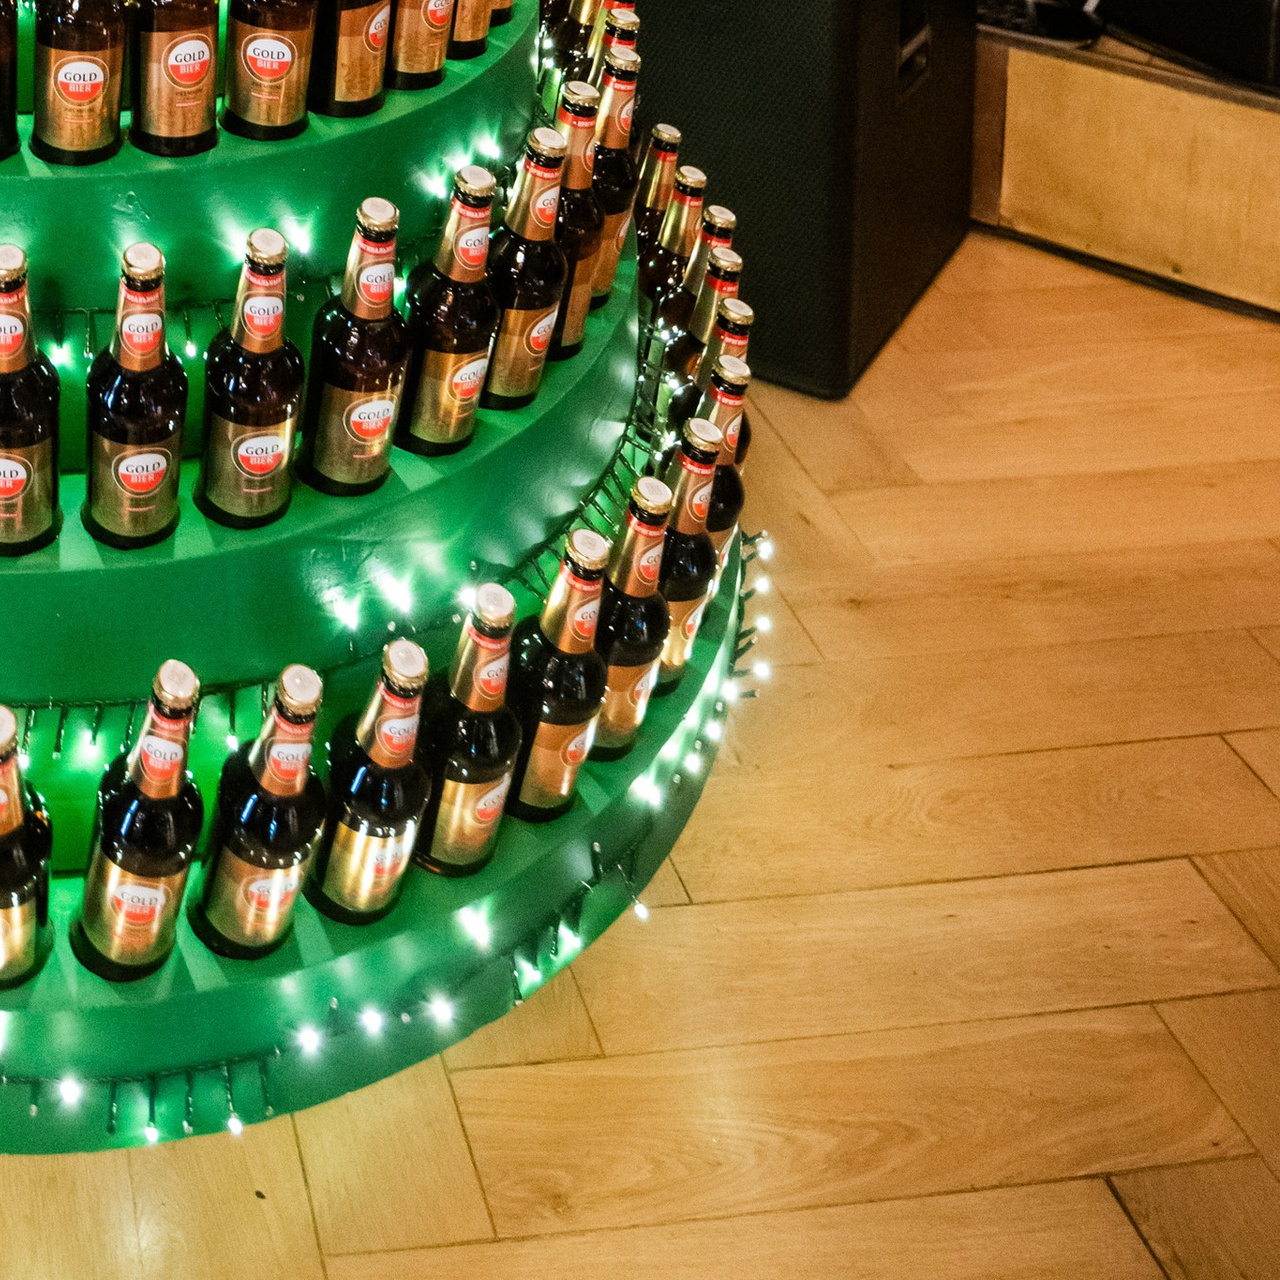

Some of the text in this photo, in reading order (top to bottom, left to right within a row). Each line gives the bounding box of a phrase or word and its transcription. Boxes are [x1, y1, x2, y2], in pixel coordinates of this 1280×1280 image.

[175, 50, 205, 63] GOLD
[252, 48, 286, 61] GOLD
[179, 63, 200, 74] BIER
[257, 59, 279, 71] BIER
[64, 71, 98, 83] GOLD
[69, 83, 91, 93] BIER
[366, 271, 394, 285] GOLD
[249, 303, 280, 316] GOLD
[253, 314, 275, 326] BIER
[127, 322, 159, 334] GOLD
[132, 333, 154, 345] BIER
[357, 406, 390, 421] GOLD
[362, 419, 385, 431] BIER
[245, 442, 280, 457] GOLD
[249, 454, 274, 466] BIER
[125, 461, 161, 474] GOLD
[130, 472, 155, 484] BIER
[146, 743, 178, 761] GOLD
[277, 750, 310, 762] GOLD
[121, 892, 159, 906] GOLD
